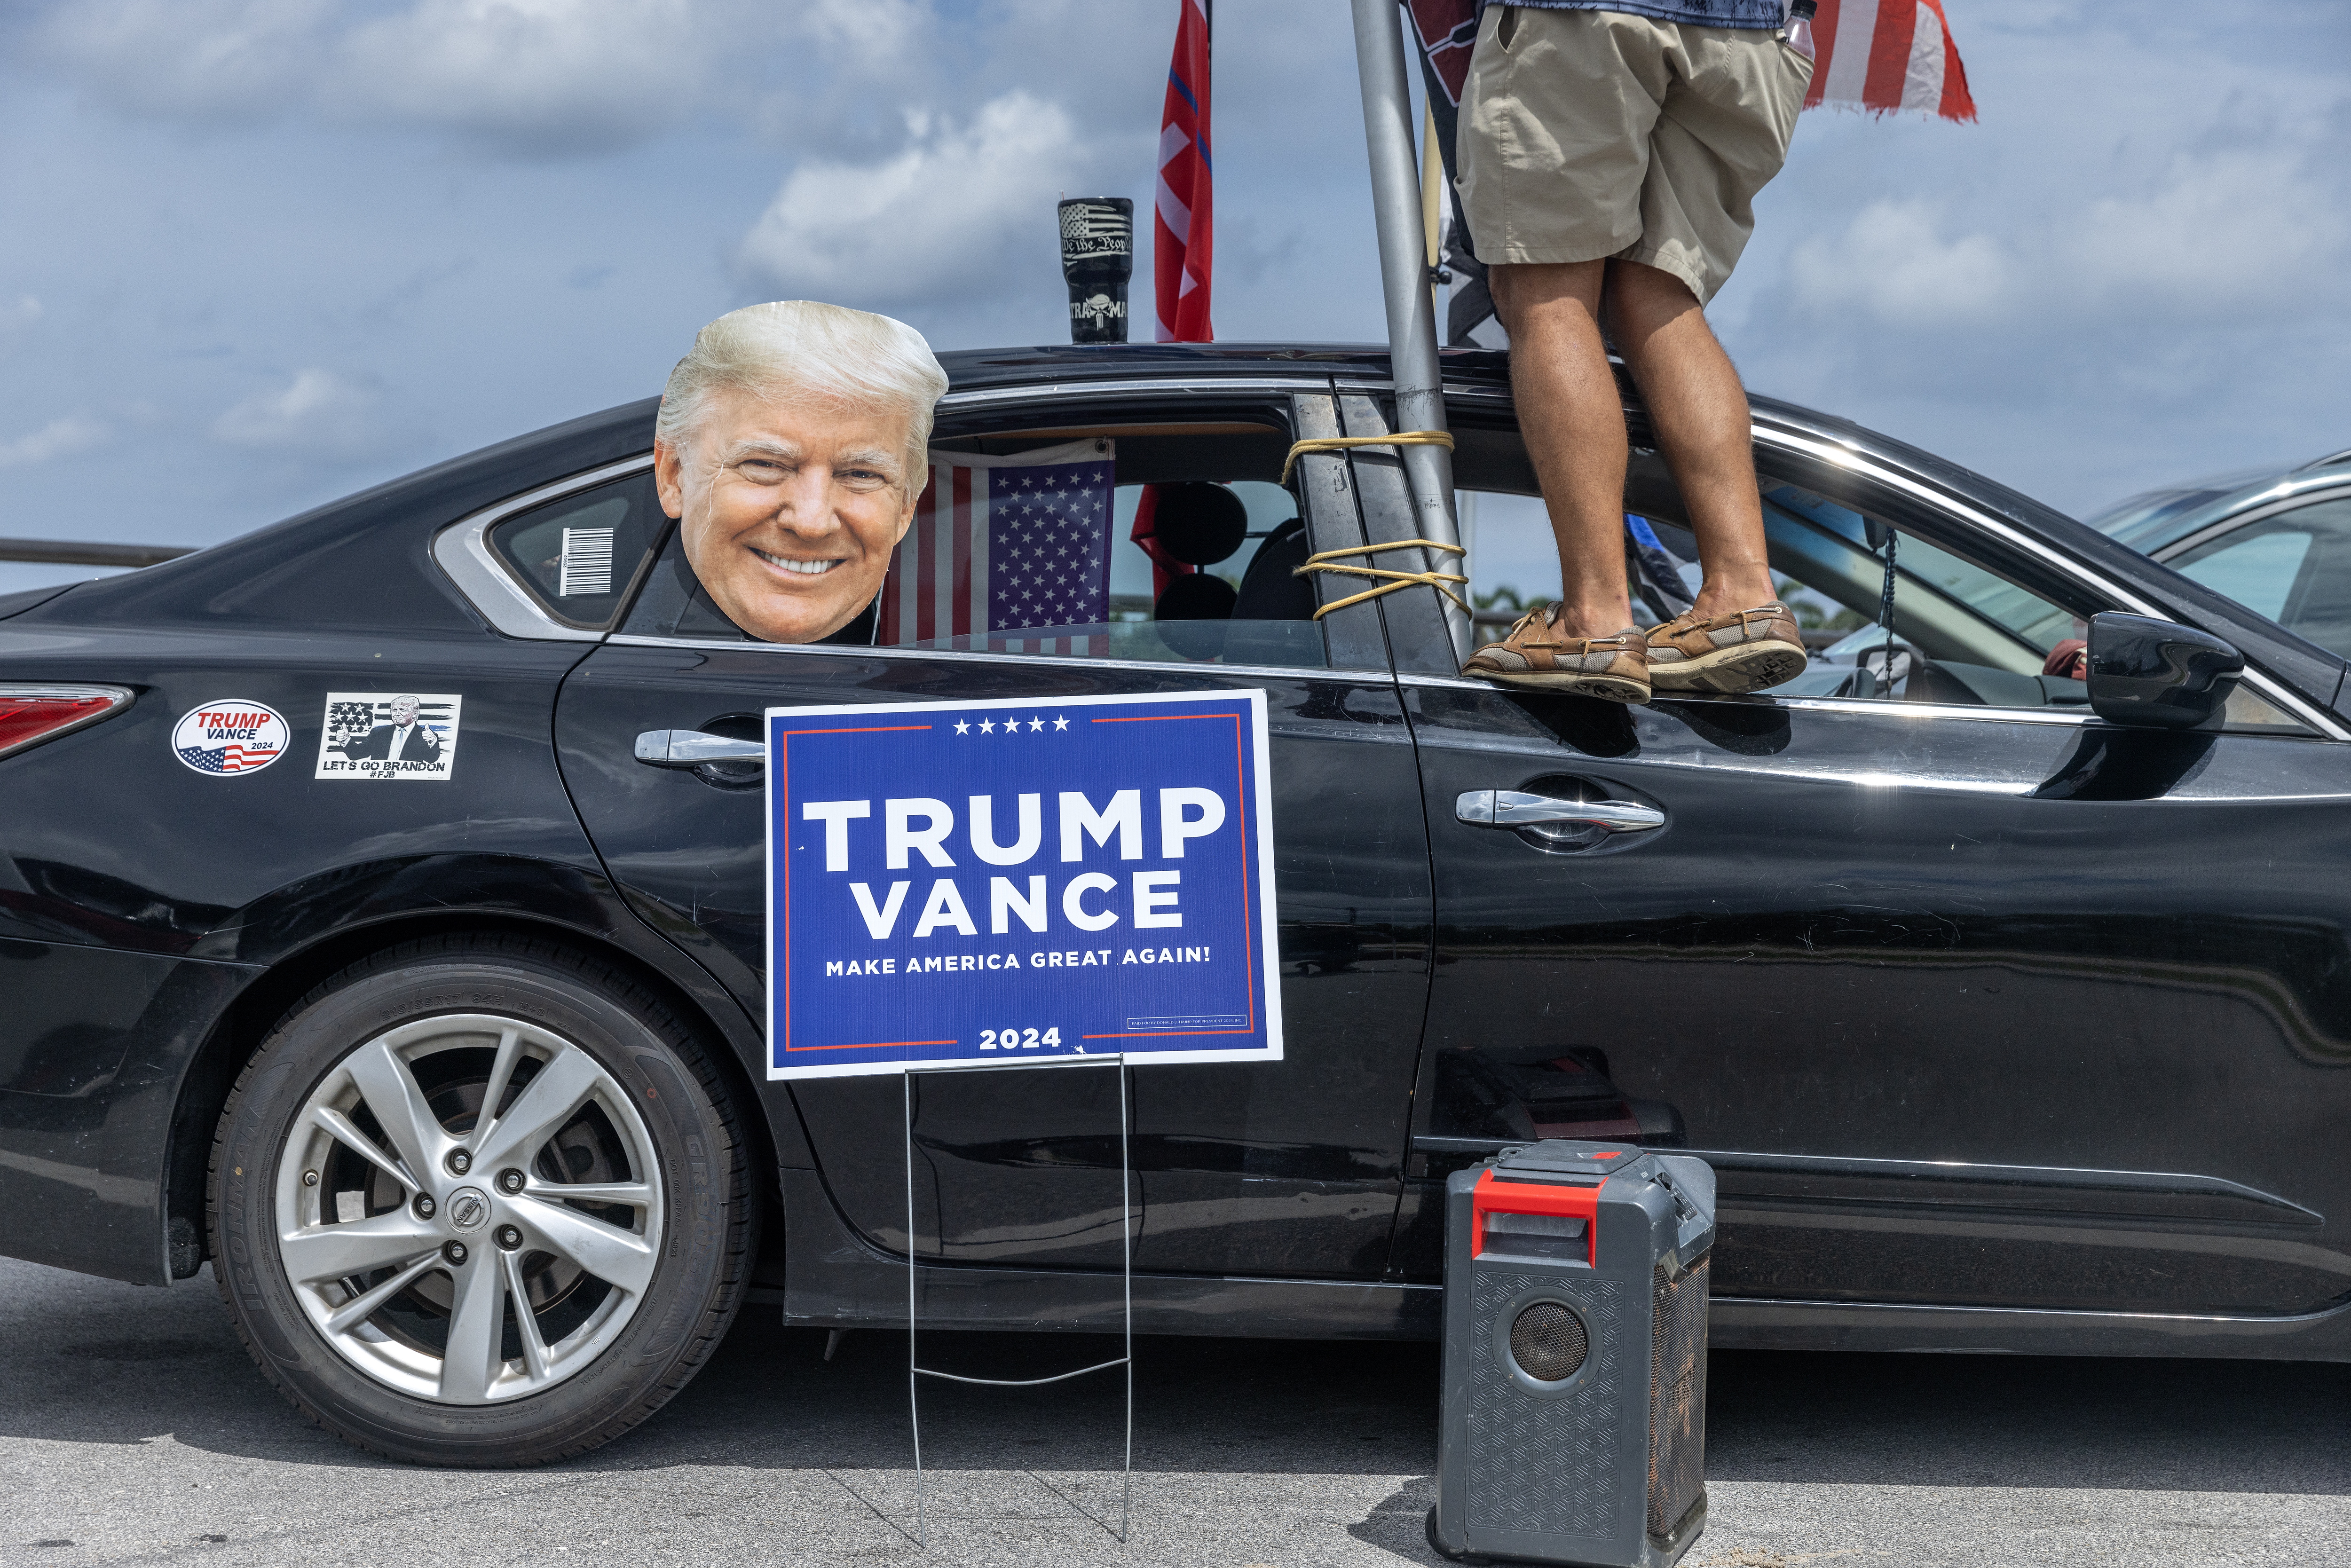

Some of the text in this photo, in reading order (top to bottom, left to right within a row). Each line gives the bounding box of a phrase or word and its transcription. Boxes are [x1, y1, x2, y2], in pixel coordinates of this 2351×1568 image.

[1061, 238, 1075, 253] We
[1069, 238, 1096, 253] the
[1109, 301, 1128, 318] MA
[198, 712, 271, 728] TRUMP
[207, 728, 257, 740] VANCE
[251, 741, 273, 750] 2024
[361, 761, 380, 771] GO
[383, 761, 445, 772] BRANDON
[803, 787, 1226, 872] TRUMP
[849, 870, 1183, 940] VANCE
[827, 947, 1209, 976] MAKE AMERICA GREAT AGAIN!
[381, 993, 546, 1021] 215/55R17 94H M+S
[980, 1027, 1061, 1049] 2024
[669, 1158, 678, 1175] DOT
[227, 1106, 265, 1311] IRONMAN
[457, 1197, 479, 1223] NISSAN
[686, 1135, 710, 1275] GR906
[670, 1239, 680, 1258] 4823
